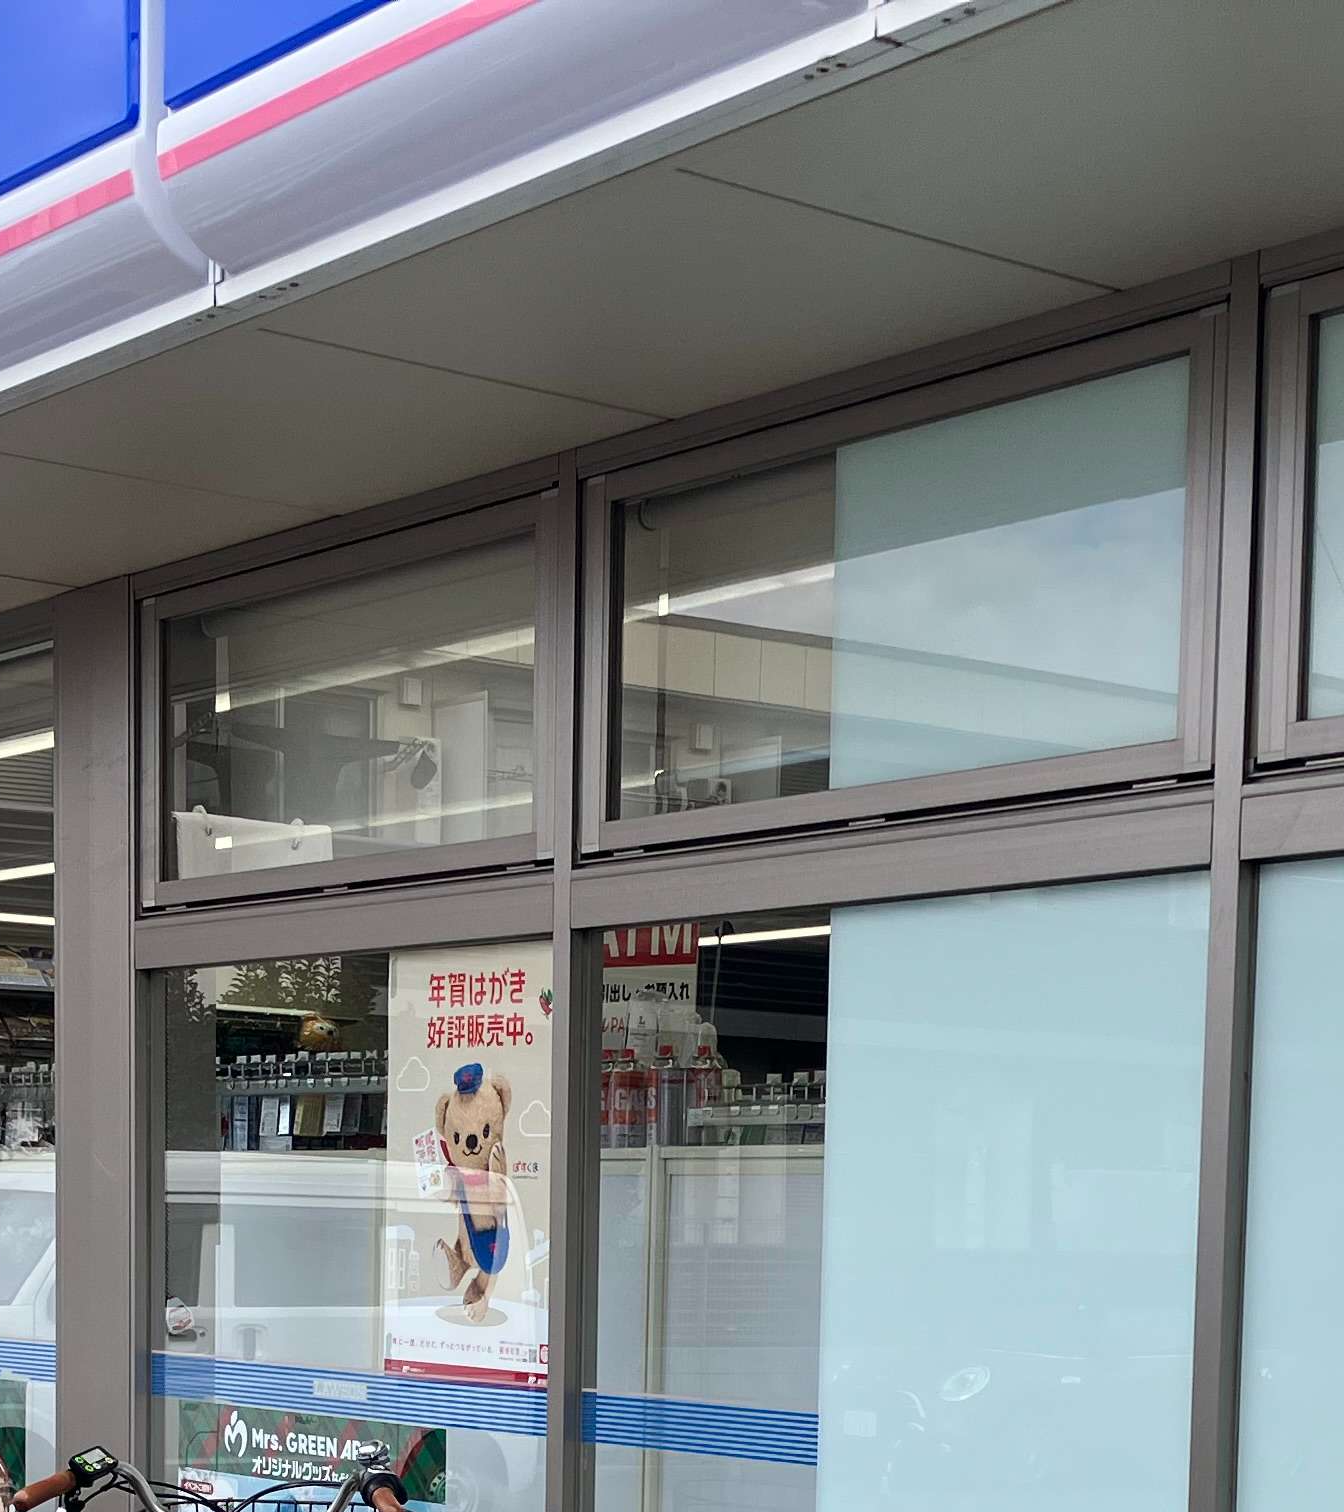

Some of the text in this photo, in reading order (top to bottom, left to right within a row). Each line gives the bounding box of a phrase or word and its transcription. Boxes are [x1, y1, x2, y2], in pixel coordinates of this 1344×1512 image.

[428, 969, 527, 1008] 年賀はがき
[426, 1011, 534, 1050] 好評販売中。
[252, 1427, 283, 1451] Mrs.
[286, 1432, 338, 1459] GREEN
